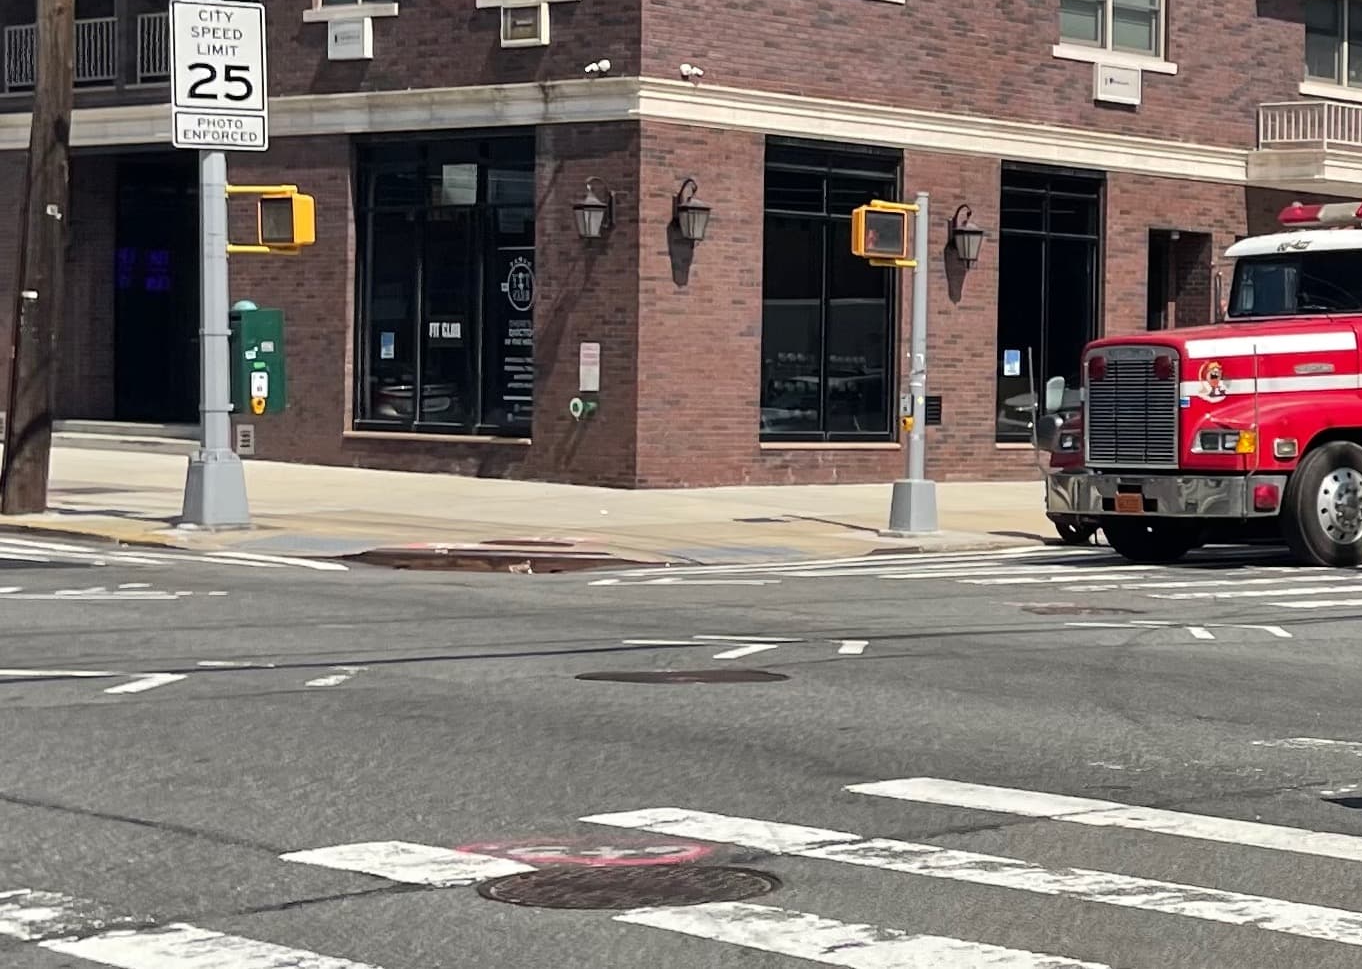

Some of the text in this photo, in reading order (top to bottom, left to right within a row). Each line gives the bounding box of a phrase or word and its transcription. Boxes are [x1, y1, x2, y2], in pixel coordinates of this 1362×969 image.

[198, 9, 234, 22] CITY
[191, 26, 243, 40] SPEED
[197, 44, 239, 57] LIMIT
[187, 62, 253, 101] 25
[197, 118, 243, 129] PHOTO
[183, 129, 258, 142] ENFORCED
